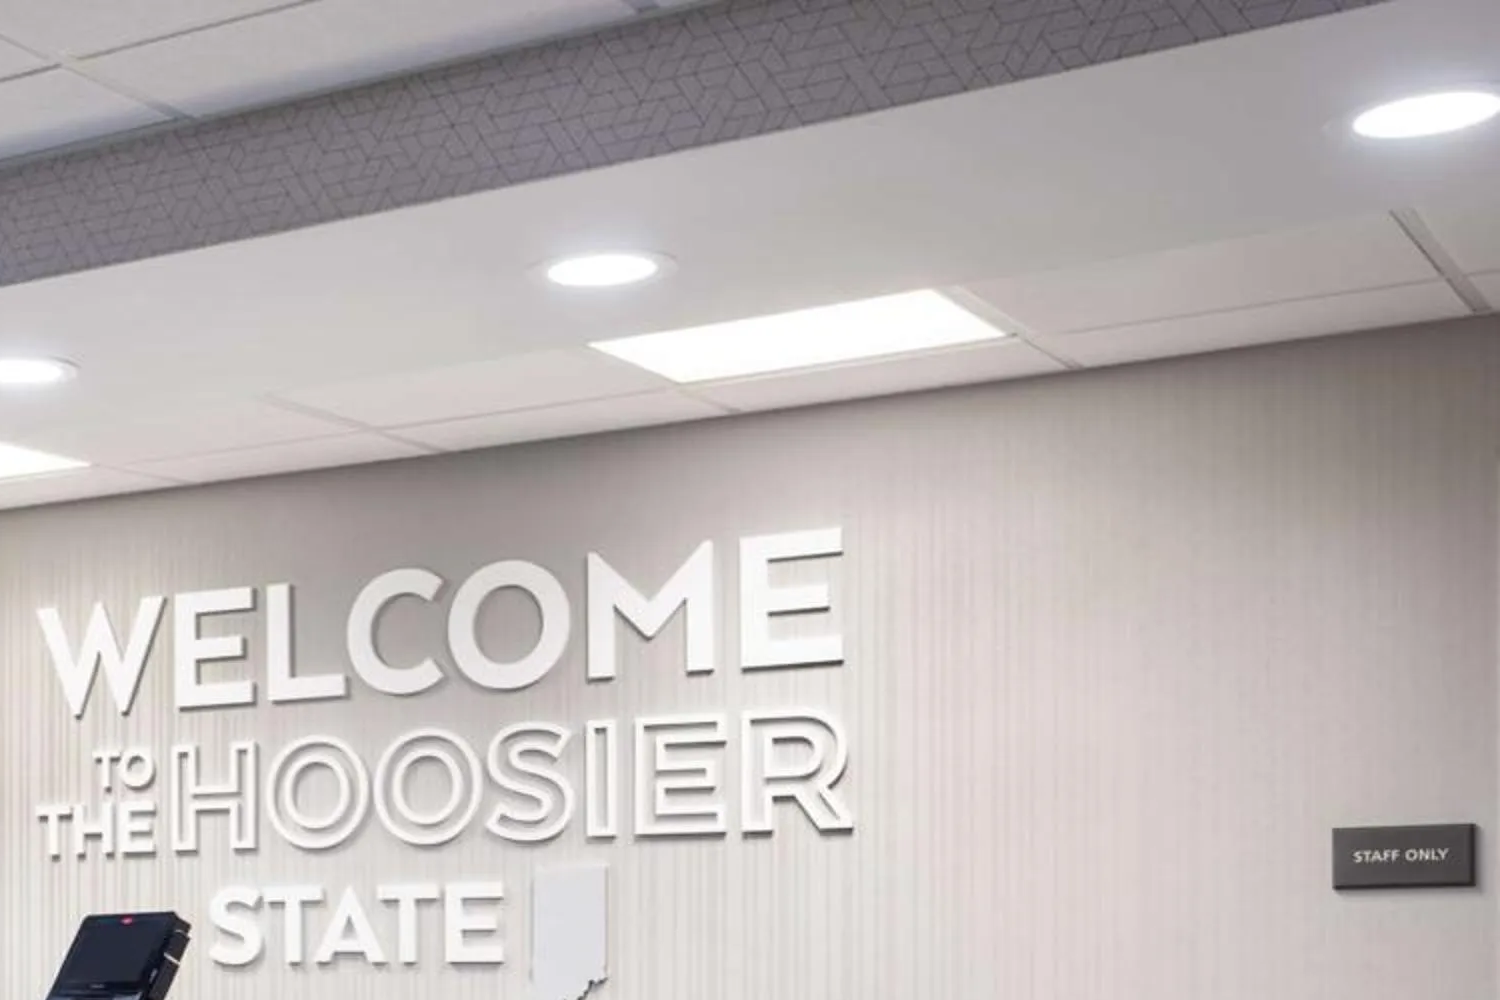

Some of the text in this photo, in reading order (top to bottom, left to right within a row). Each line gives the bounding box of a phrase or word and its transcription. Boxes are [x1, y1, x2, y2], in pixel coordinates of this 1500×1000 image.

[37, 527, 845, 718] WELCOME
[93, 746, 156, 792] TO
[170, 707, 854, 854] HOOSIER
[37, 801, 157, 859] THE
[1352, 847, 1449, 864] STAFF ONLY
[208, 880, 506, 969] STATE
